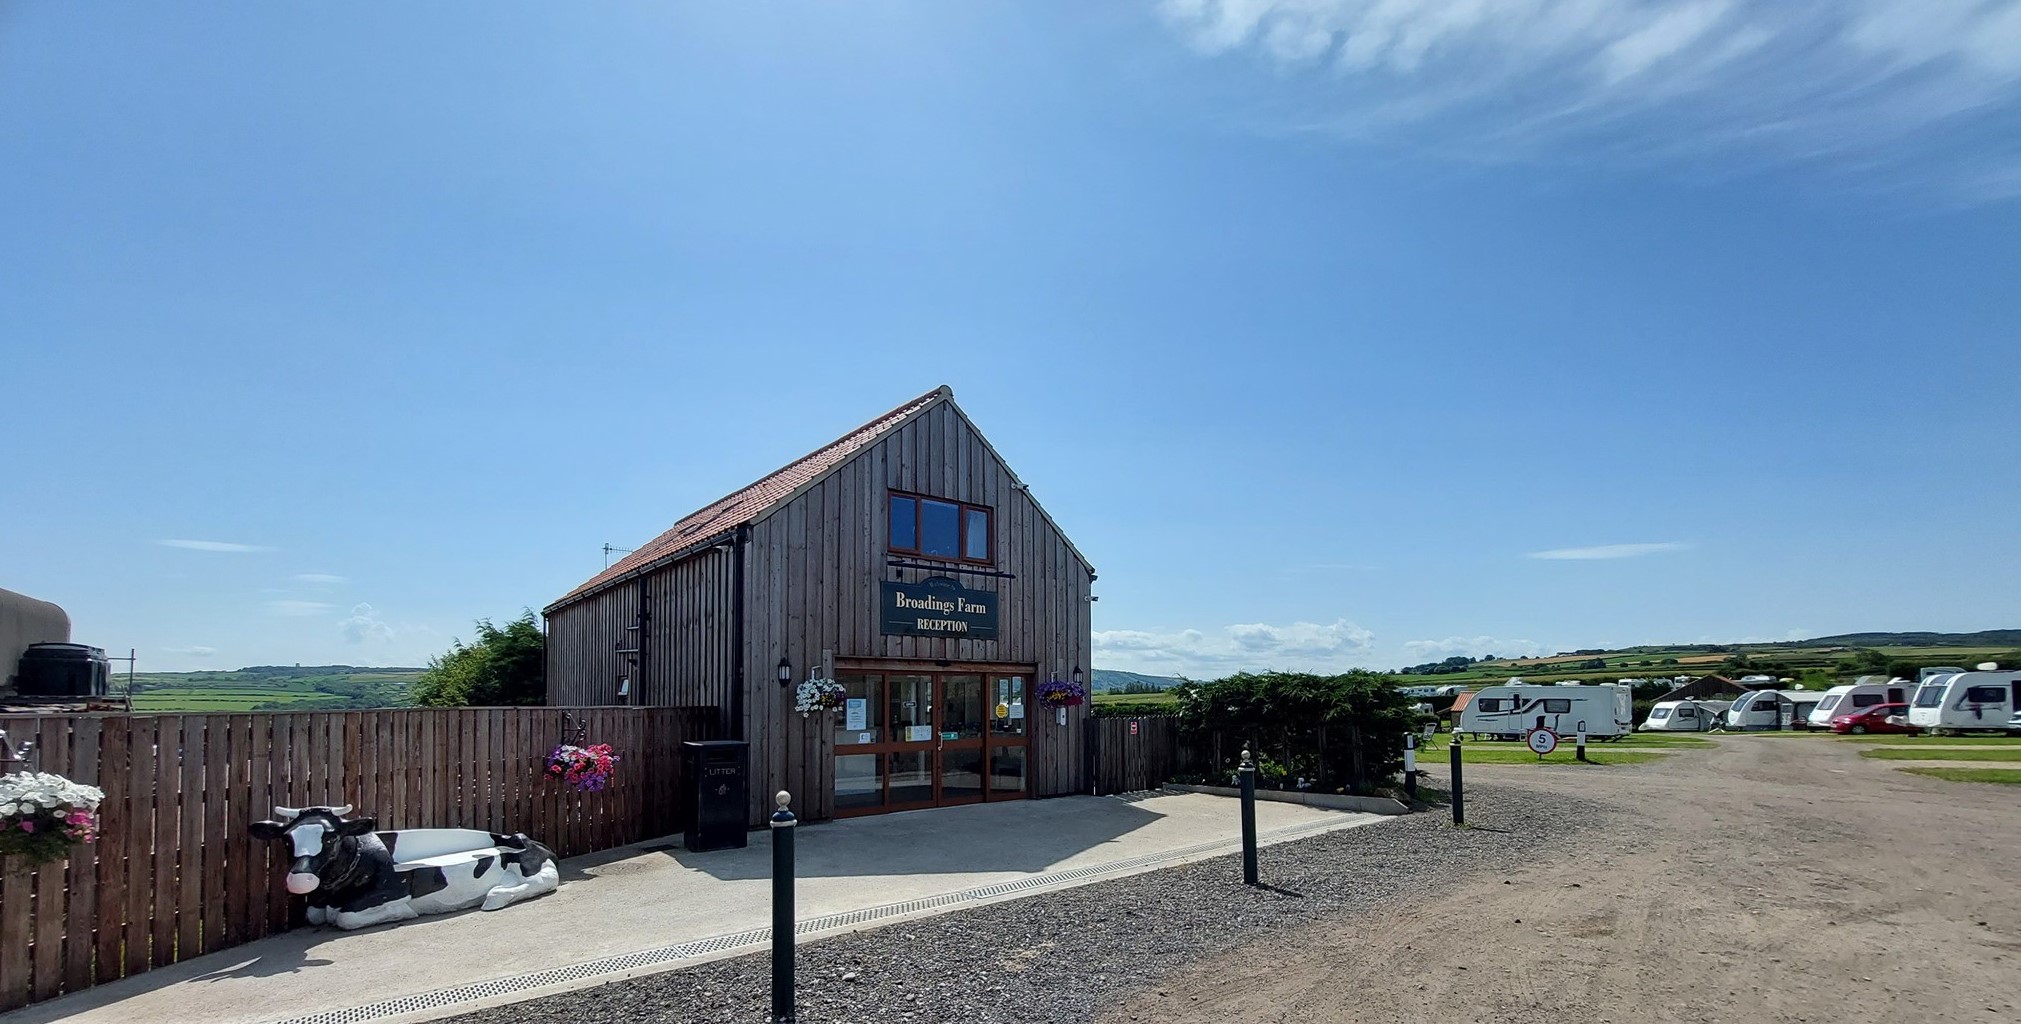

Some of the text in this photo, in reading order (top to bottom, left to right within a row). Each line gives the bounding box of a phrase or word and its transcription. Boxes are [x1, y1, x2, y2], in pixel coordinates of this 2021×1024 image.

[896, 592, 986, 615] Broadings Farm
[917, 618, 968, 632] RECEPTION
[1538, 734, 1546, 743] 5
